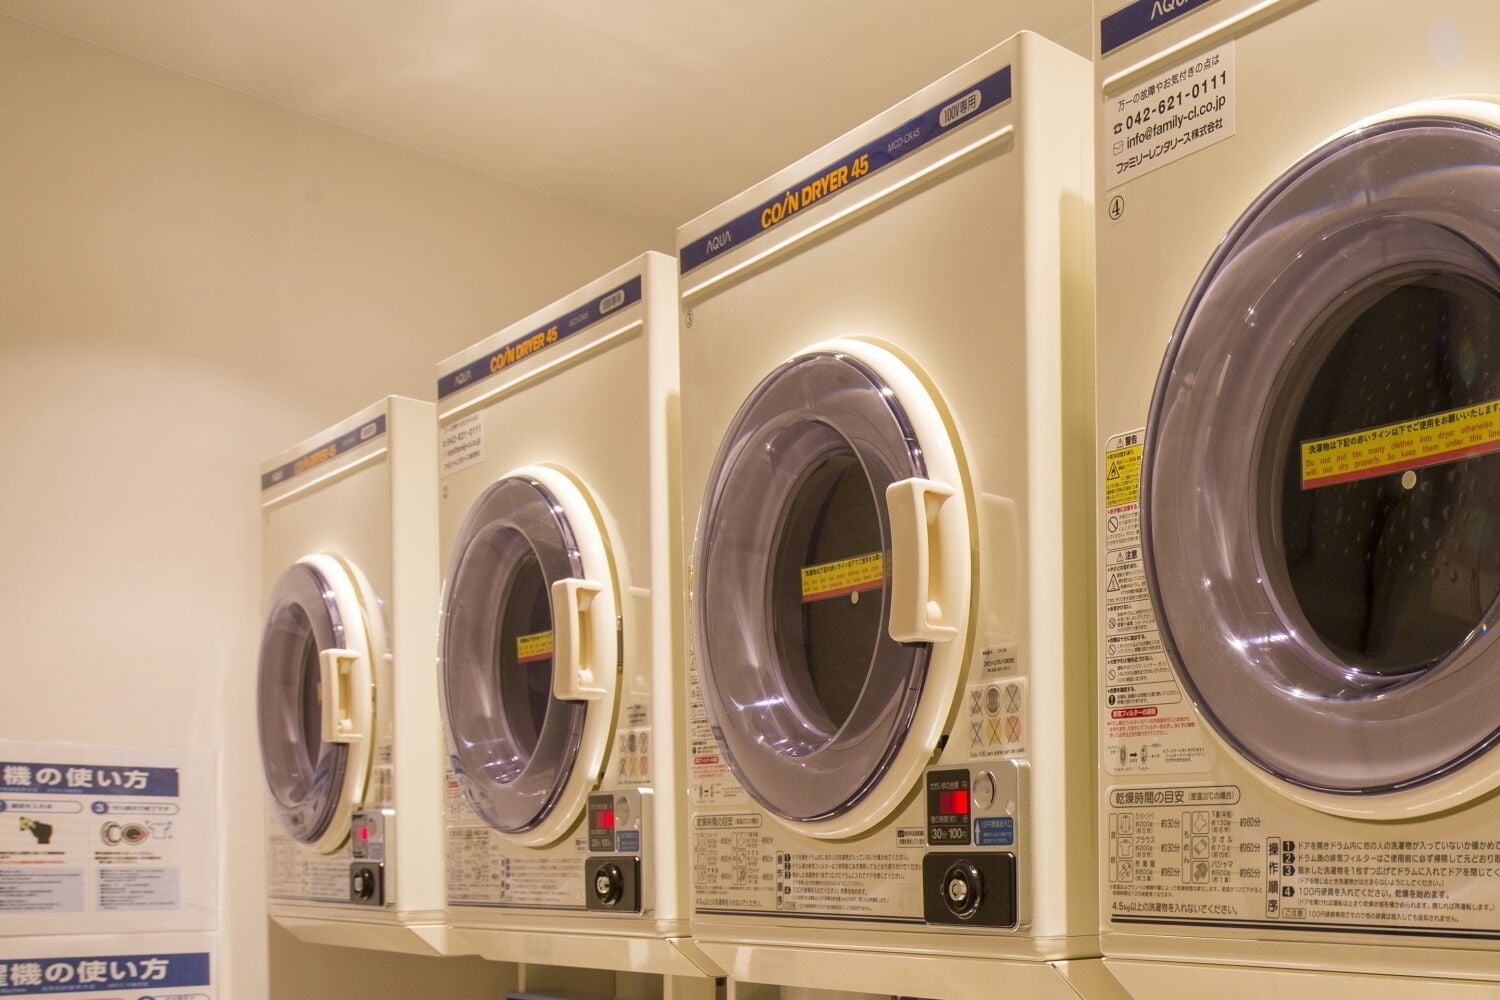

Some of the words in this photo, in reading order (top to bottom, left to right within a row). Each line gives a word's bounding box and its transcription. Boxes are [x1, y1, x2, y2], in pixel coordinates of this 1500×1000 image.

[1118, 54, 1220, 112] 万一の故障やお気付きの点は
[1126, 71, 1227, 130] 042-621-0111
[1116, 118, 1223, 174] ファミリーレンタリース株式会社
[1127, 95, 1226, 149] info@family-cl.co.jp
[706, 230, 732, 254] AQUA
[760, 190, 799, 229] COIN
[801, 166, 848, 208] DRYER
[851, 154, 869, 179] 45
[516, 332, 545, 360] DRYER
[546, 326, 558, 341] 45
[1320, 455, 1331, 464] not
[1336, 453, 1347, 463] put
[1391, 438, 1414, 449] clothes
[1419, 434, 1433, 443] into
[1460, 421, 1494, 434] otherwise
[3, 765, 150, 789] 機の使い方
[1116, 790, 1184, 805] 乾燥時間の目安
